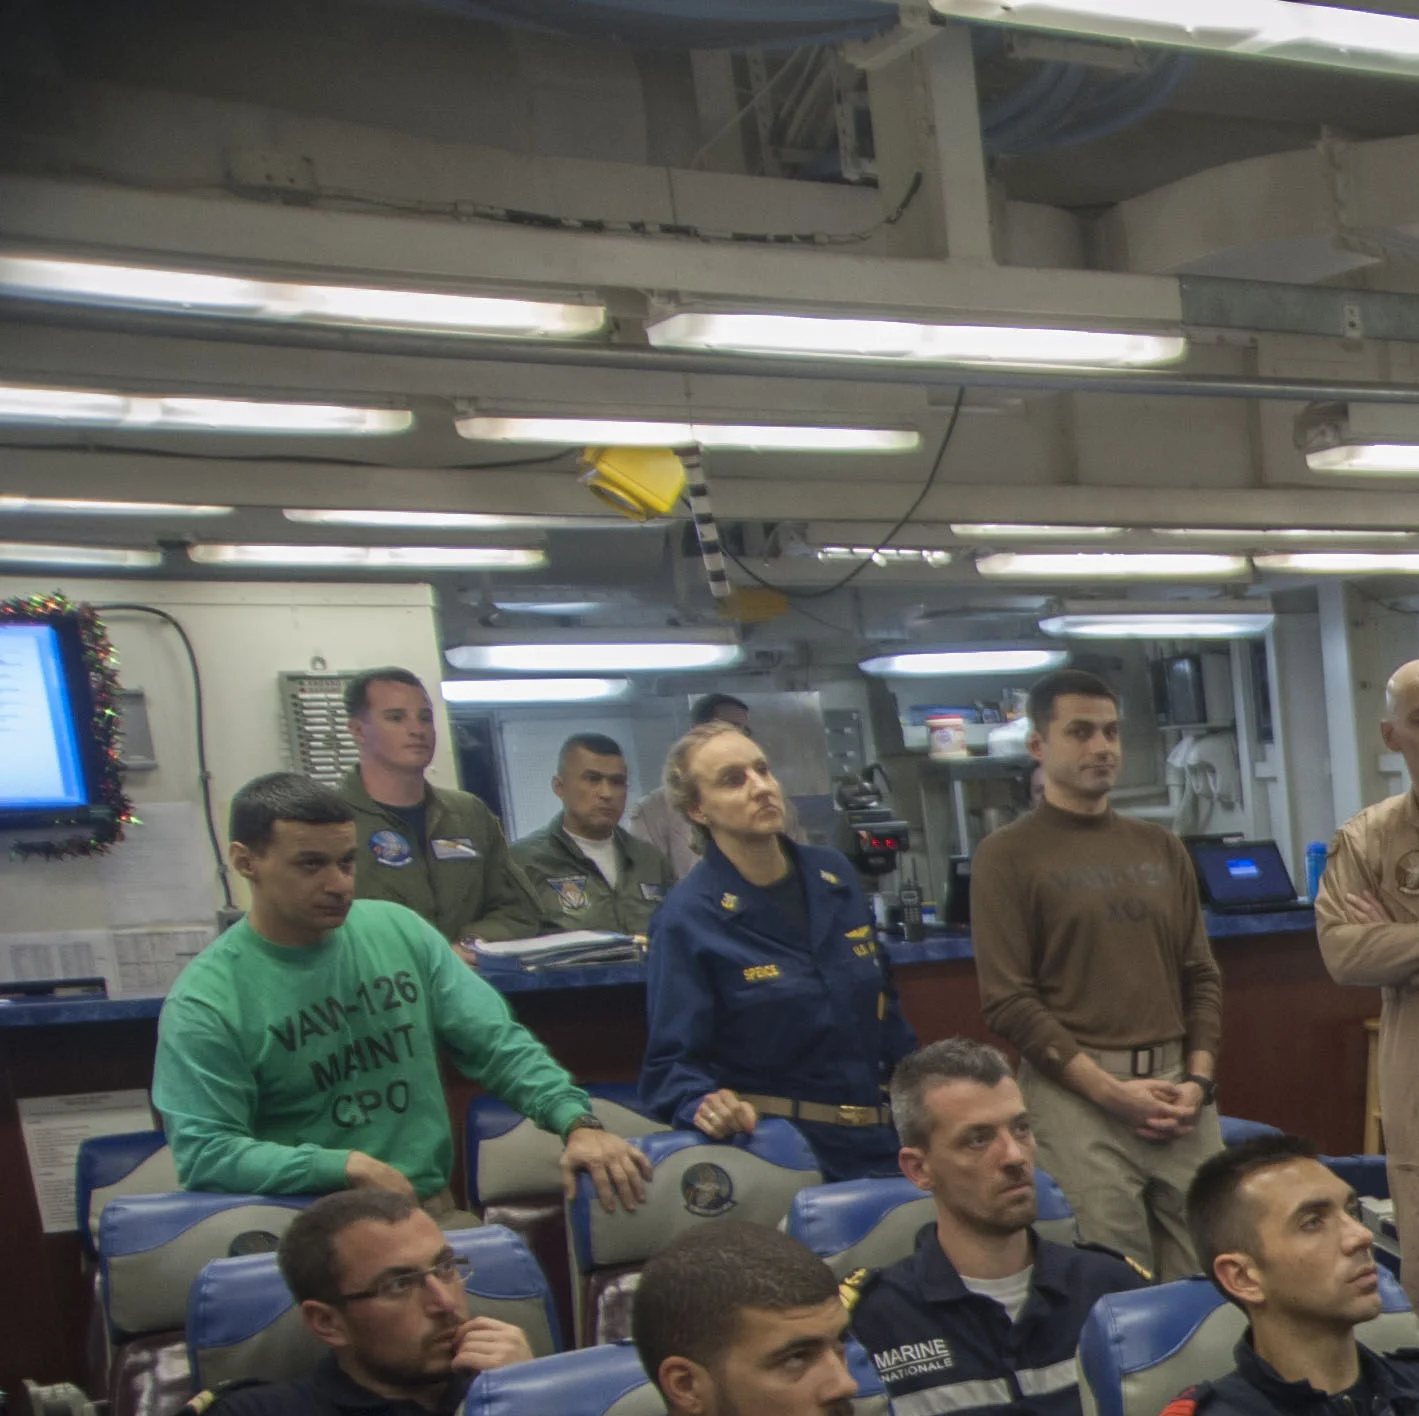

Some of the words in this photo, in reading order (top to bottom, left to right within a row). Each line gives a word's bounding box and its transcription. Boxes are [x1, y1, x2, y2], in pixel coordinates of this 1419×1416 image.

[267, 970, 418, 1052] VAW-126
[308, 1023, 415, 1092] MAINT
[332, 1079, 409, 1129] CPO
[873, 1338, 950, 1370] MARINE
[880, 1357, 954, 1383] NATIONALE
